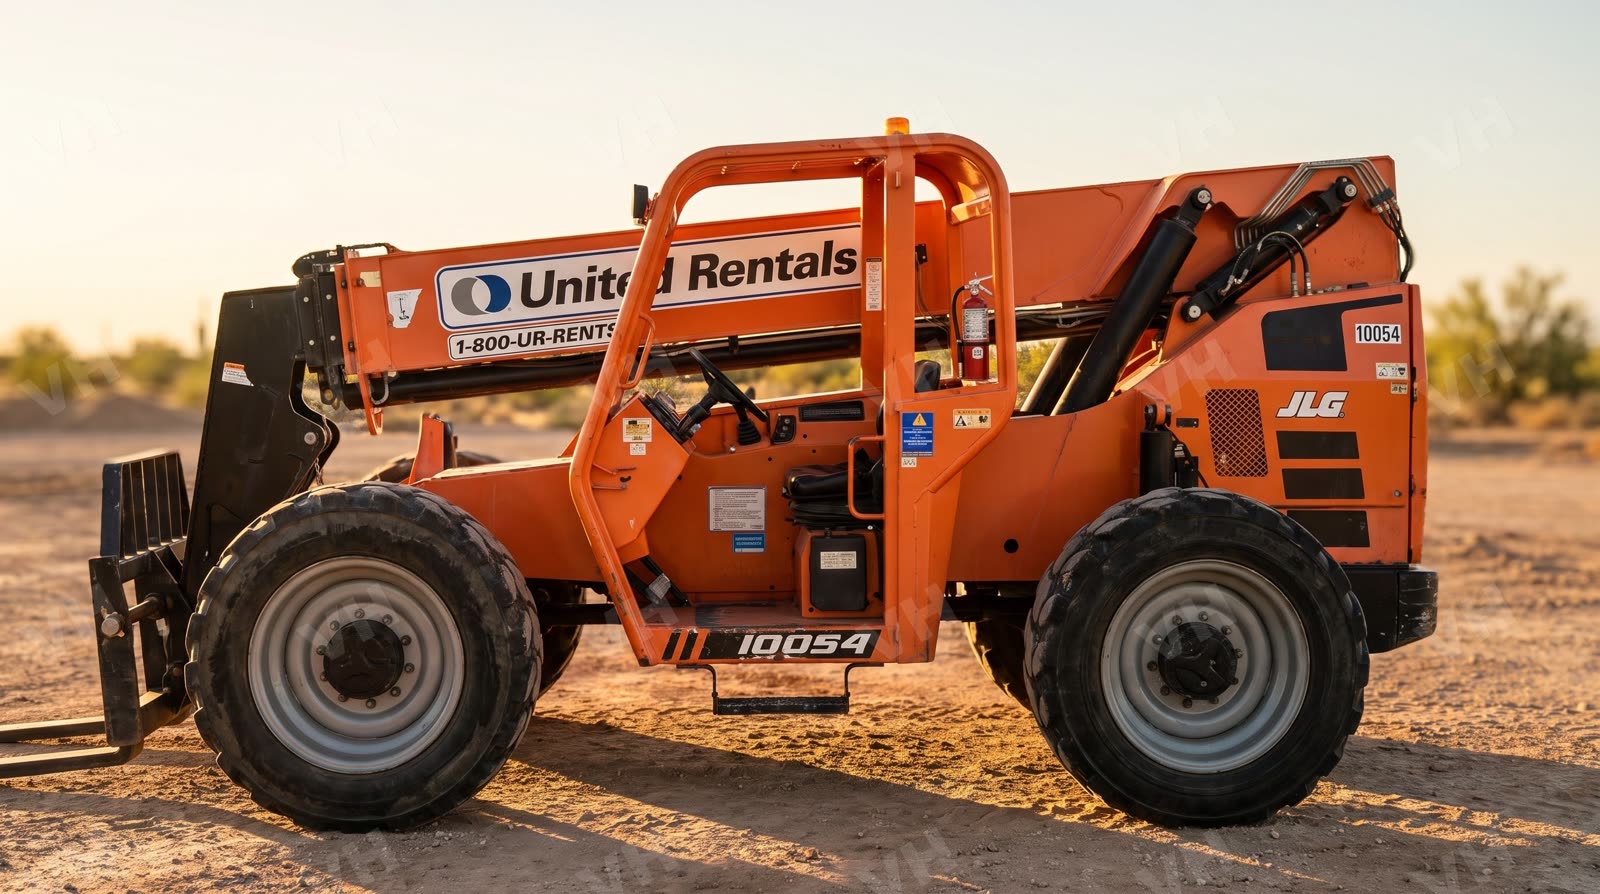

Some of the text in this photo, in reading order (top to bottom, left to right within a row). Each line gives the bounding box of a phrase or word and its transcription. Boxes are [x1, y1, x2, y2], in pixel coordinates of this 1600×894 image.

[688, 240, 857, 291] Rentals
[1356, 325, 1400, 342] 10054
[1276, 391, 1349, 418] JLG
[738, 634, 871, 654] 10054
